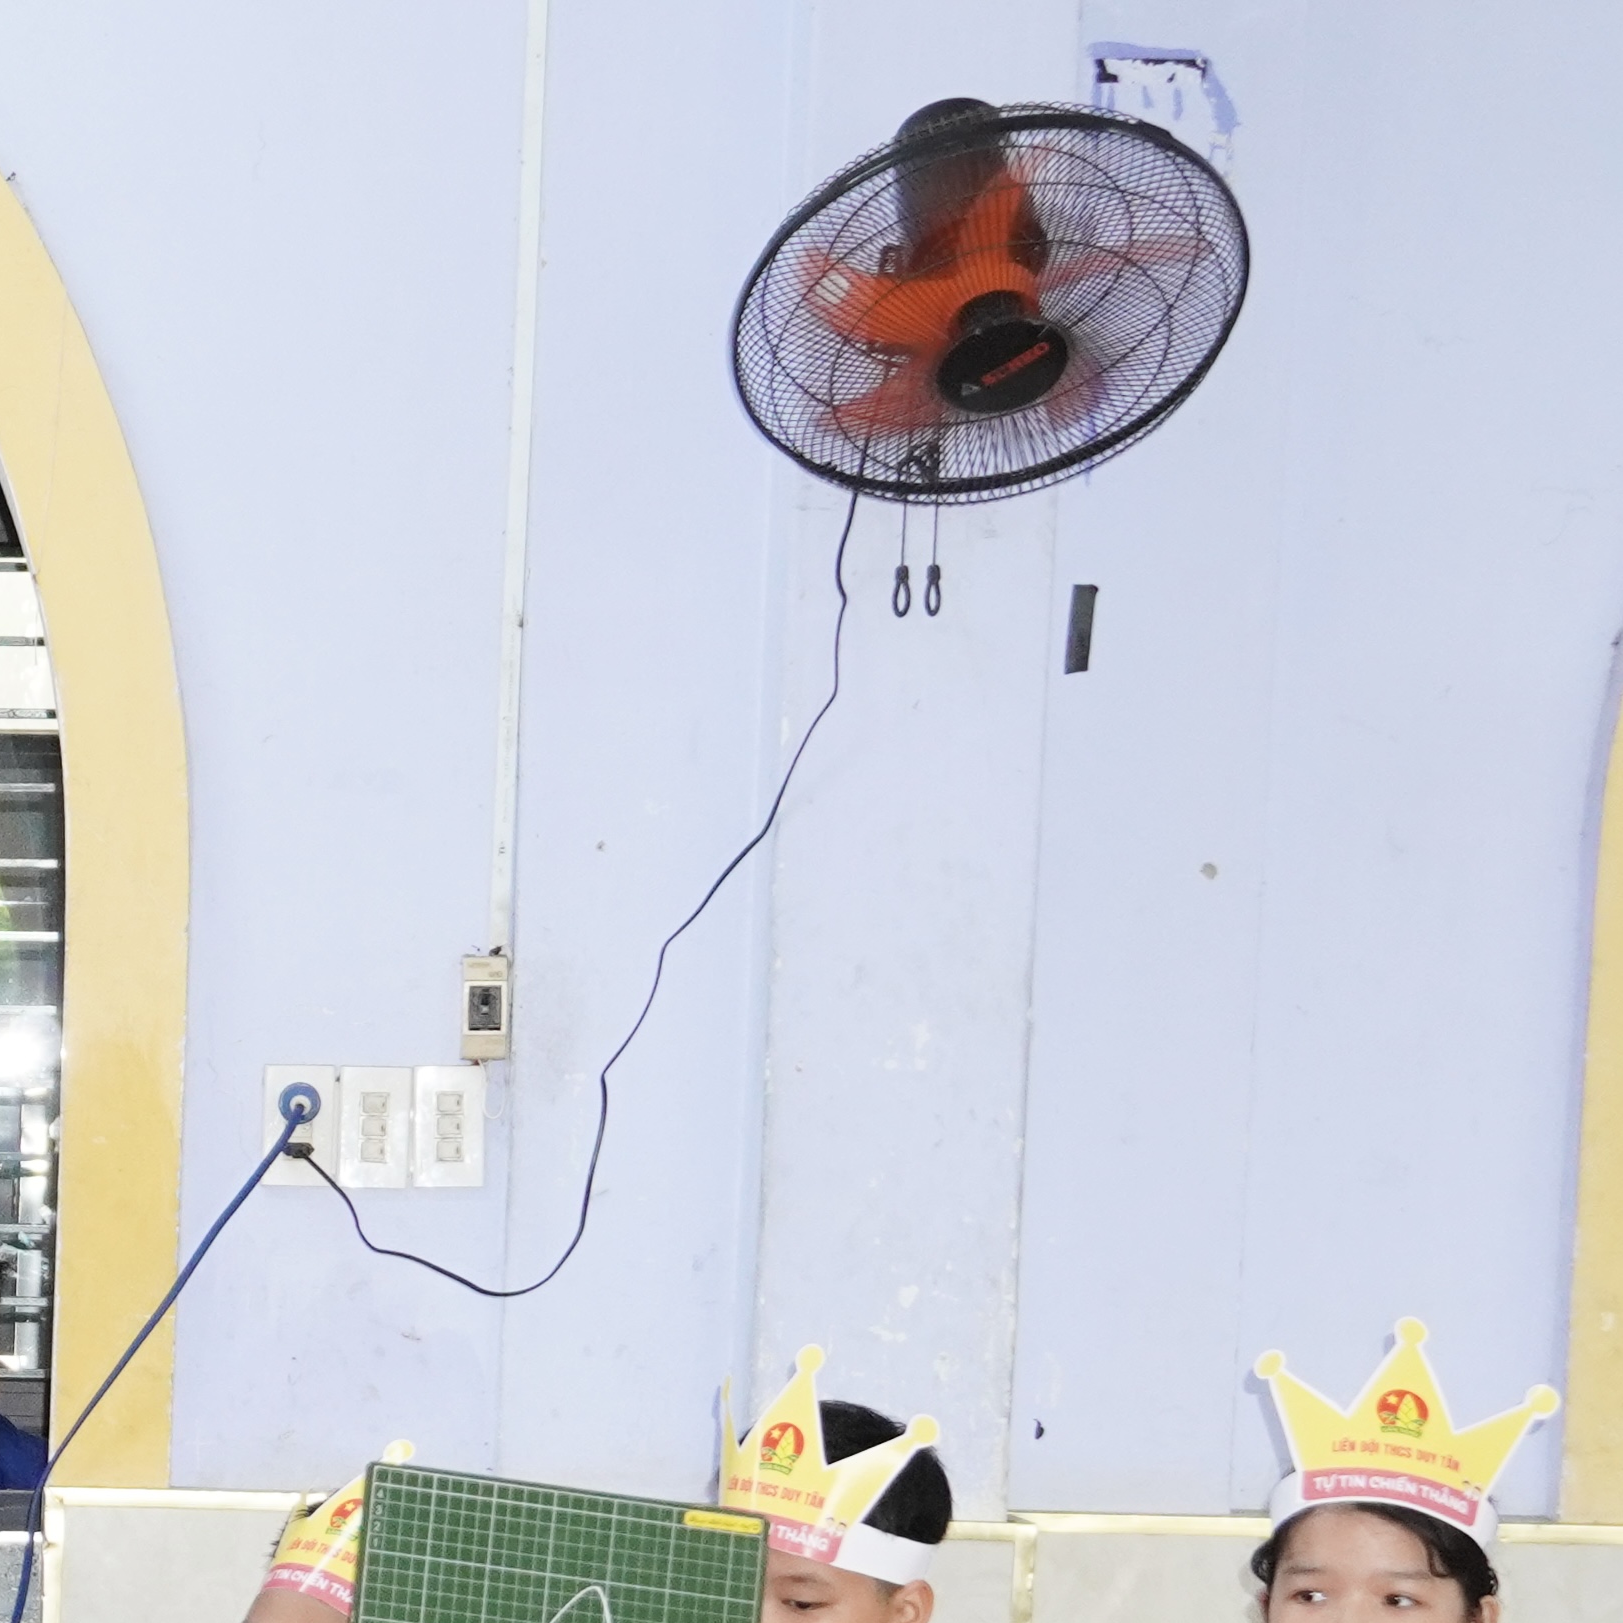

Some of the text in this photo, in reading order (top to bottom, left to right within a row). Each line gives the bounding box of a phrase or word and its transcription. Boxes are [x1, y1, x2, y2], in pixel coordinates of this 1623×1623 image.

[1339, 1474, 1366, 1488] TIN
[1369, 1475, 1418, 1496] CHIẾN
[777, 1524, 829, 1552] THẮNG
[342, 1550, 357, 1565] DU
